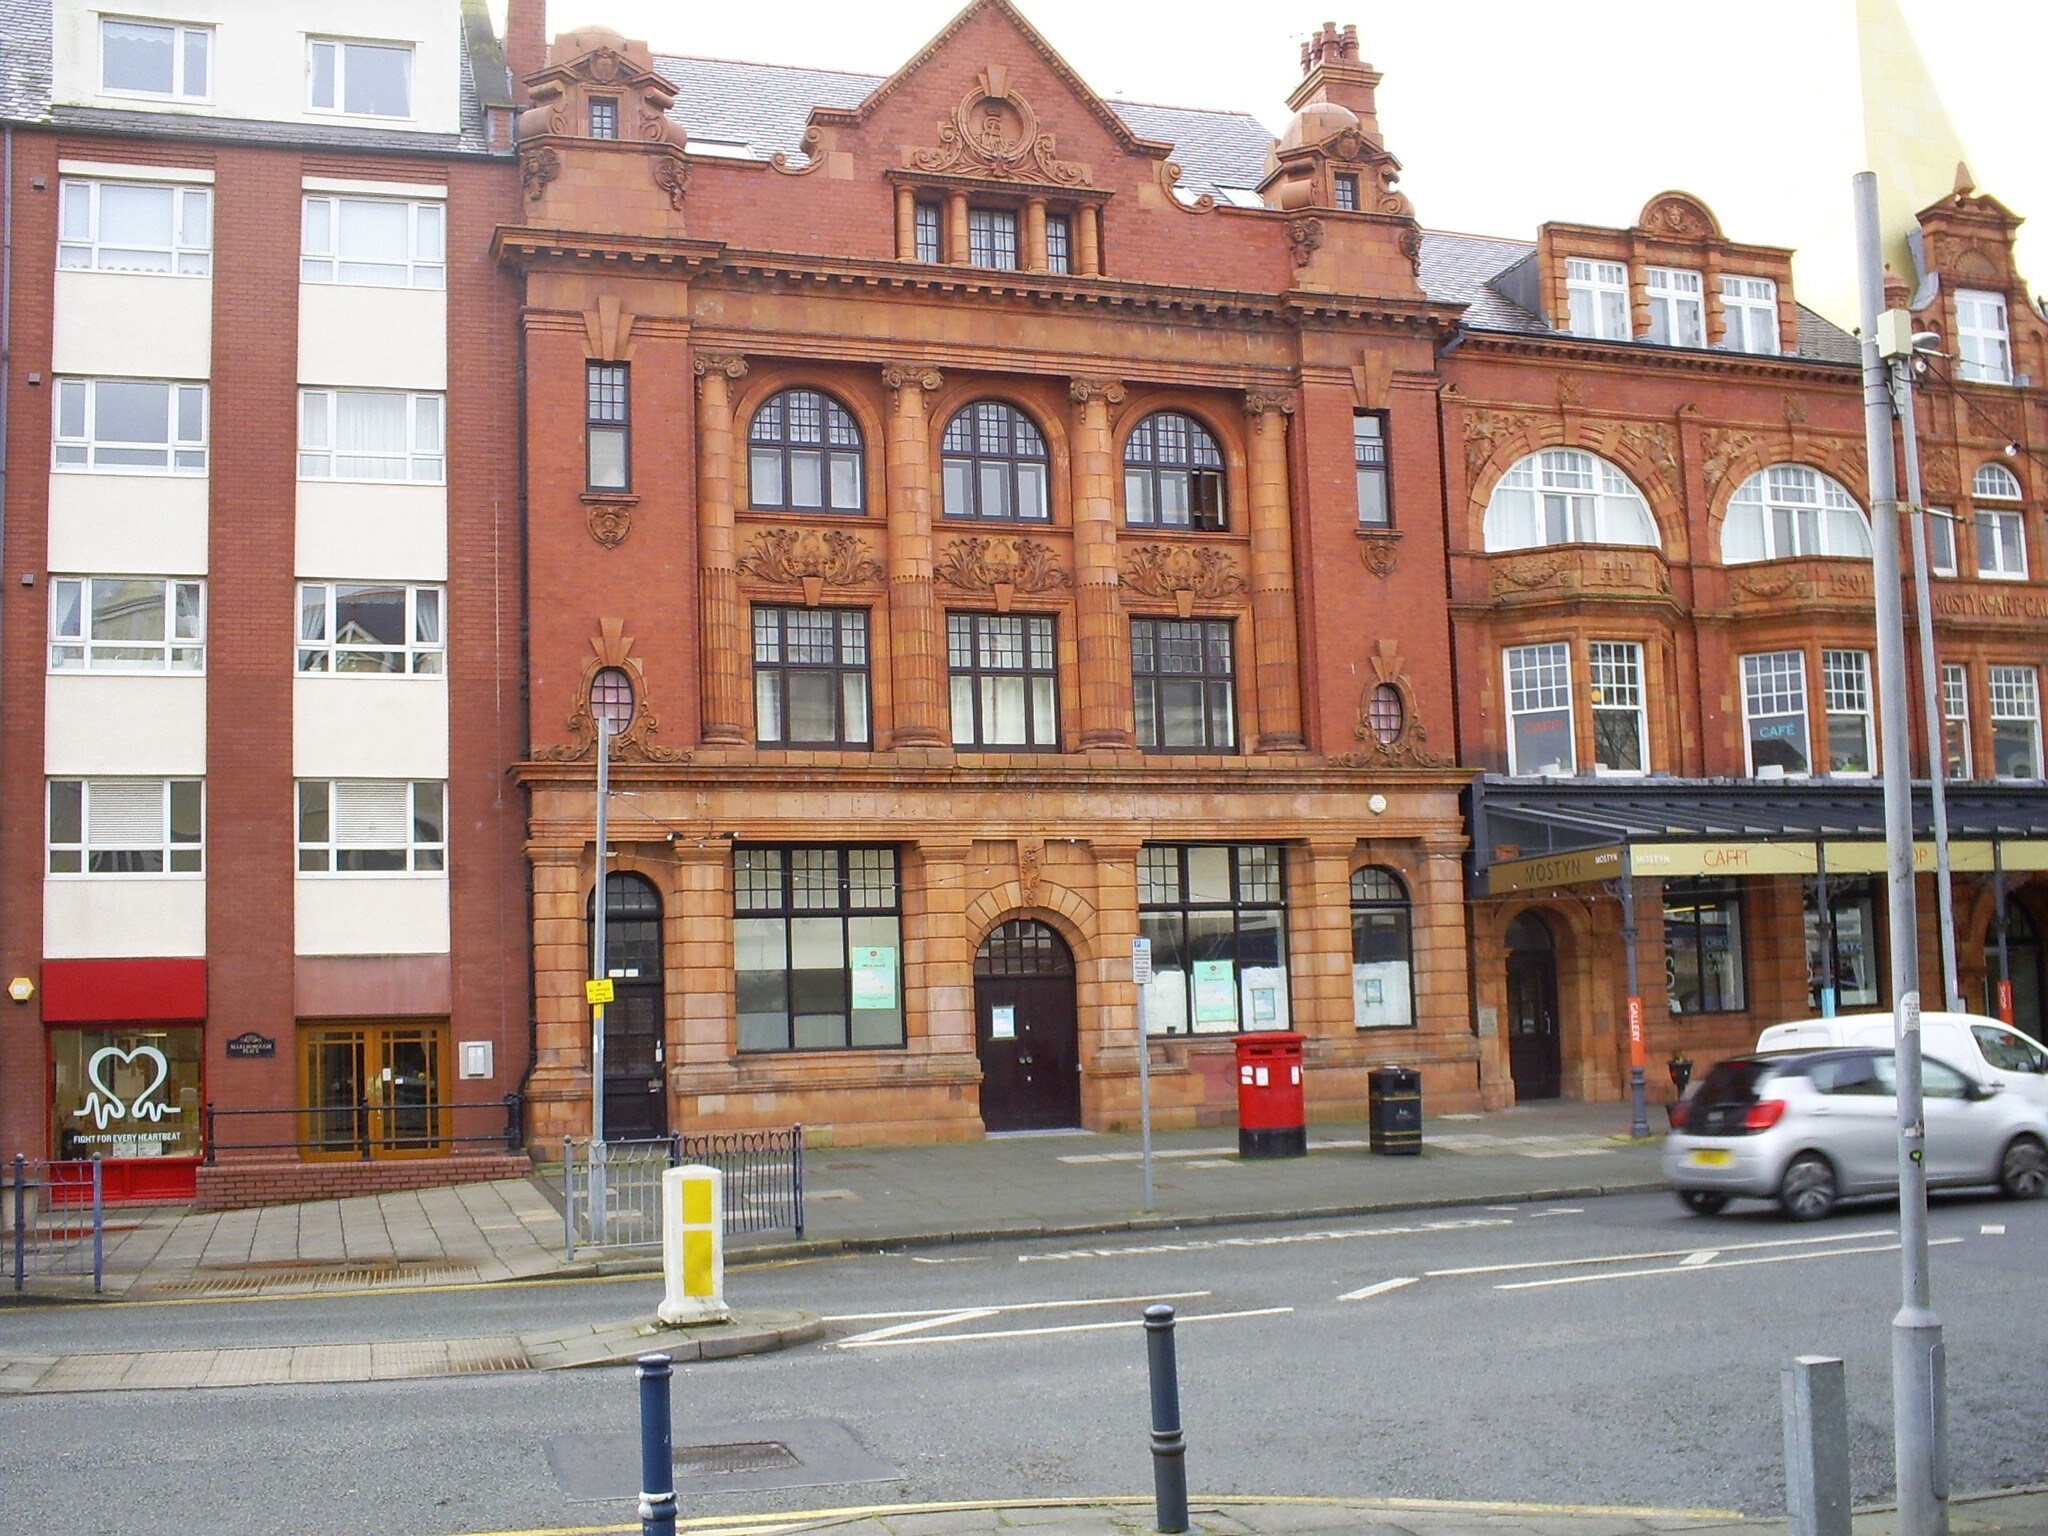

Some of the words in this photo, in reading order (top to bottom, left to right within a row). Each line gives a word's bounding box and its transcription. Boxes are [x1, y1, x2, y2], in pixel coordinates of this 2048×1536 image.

[1759, 722, 1796, 738] CAFÉ
[1594, 852, 1618, 864] MOSTYN
[1635, 855, 1670, 864] MOSTYN
[1703, 848, 1749, 867] CAFFI
[1525, 860, 1581, 882] MOSTYN
[1630, 1002, 1640, 1042] GALLERY
[73, 1134, 96, 1144] FIGHT
[97, 1134, 112, 1143] FOR
[113, 1133, 137, 1142] EVERY
[138, 1131, 181, 1142] HEARTBEAT
